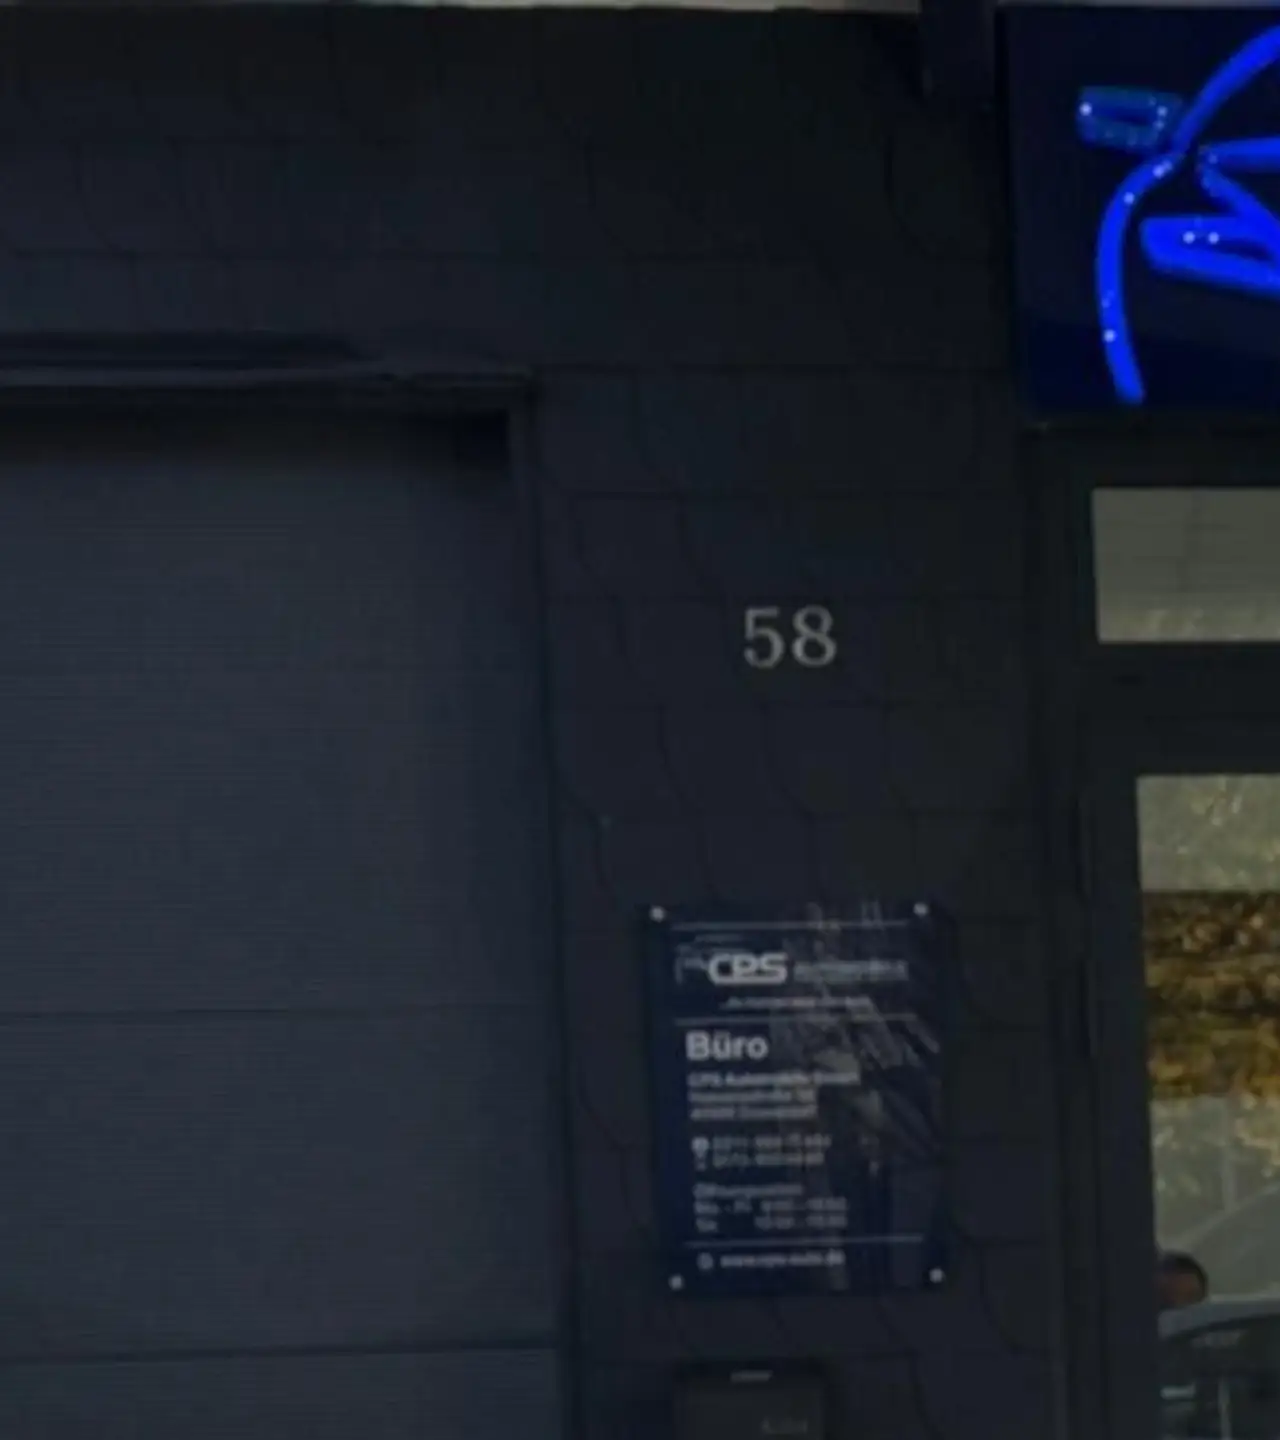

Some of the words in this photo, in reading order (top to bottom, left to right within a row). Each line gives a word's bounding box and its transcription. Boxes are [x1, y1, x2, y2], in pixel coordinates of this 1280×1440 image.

[743, 604, 837, 669] 58
[708, 953, 788, 986] CPS
[685, 1029, 769, 1061] Büro
